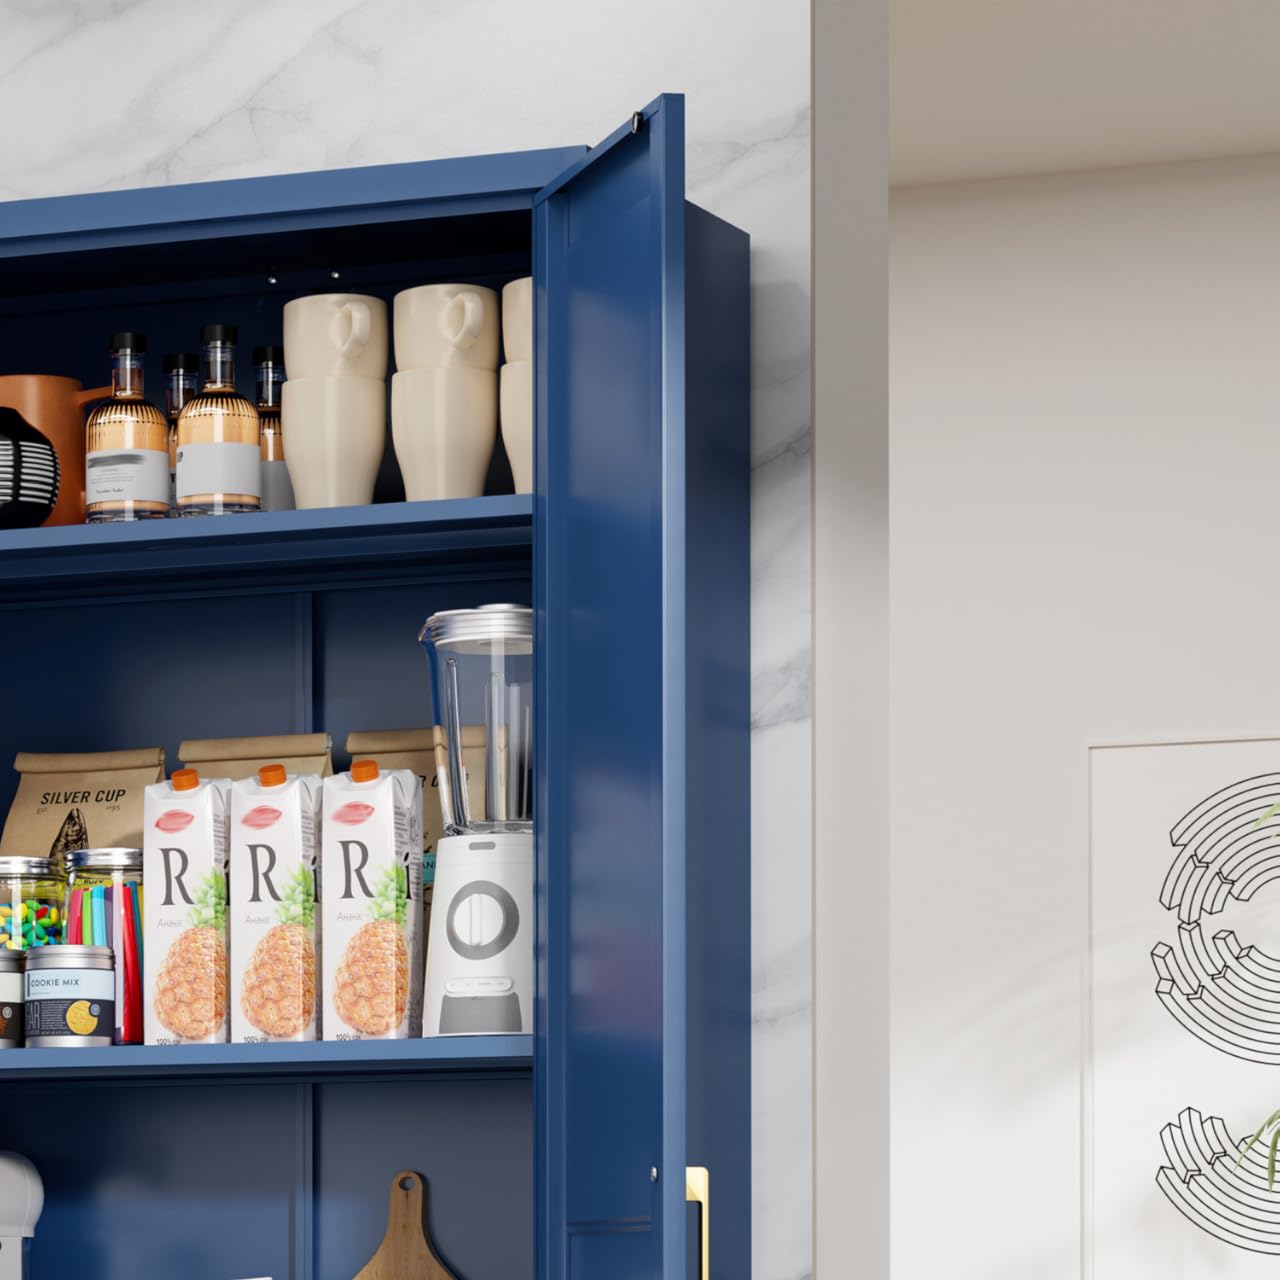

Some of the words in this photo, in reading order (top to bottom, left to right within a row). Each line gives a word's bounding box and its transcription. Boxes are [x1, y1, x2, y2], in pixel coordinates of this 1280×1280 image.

[40, 790, 91, 805] SILVER
[95, 789, 126, 803] CUP
[31, 978, 60, 987] COOKIE
[62, 978, 80, 987] MIX
